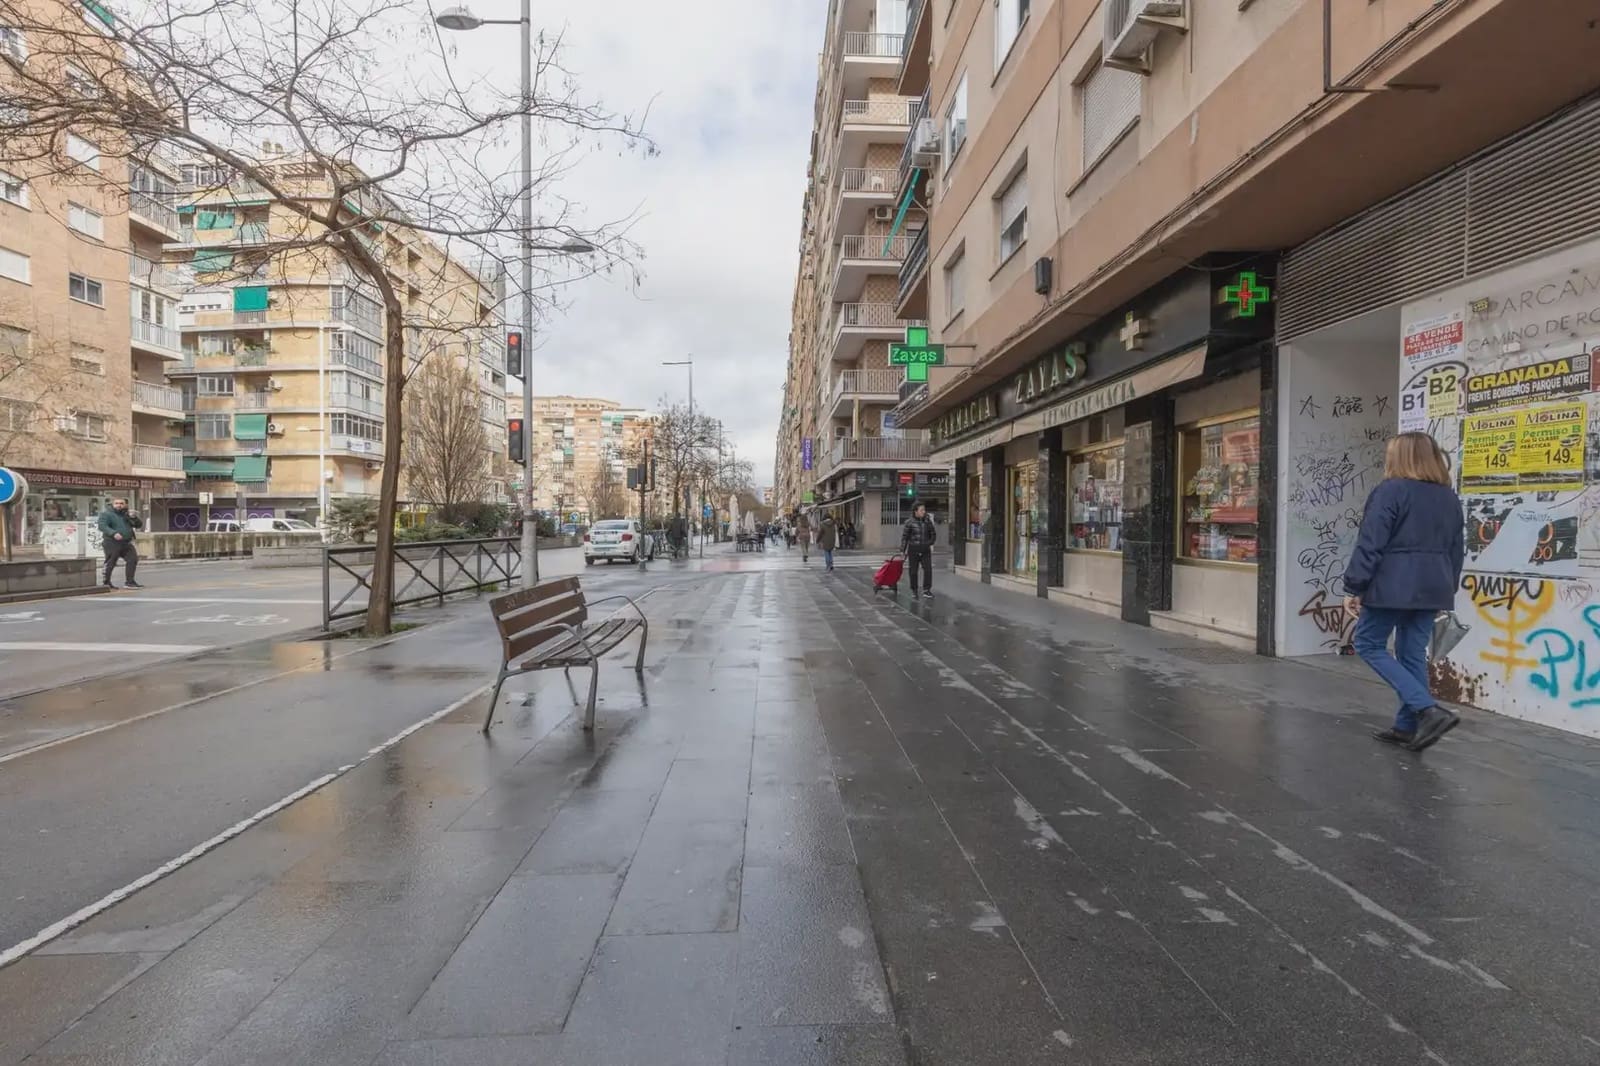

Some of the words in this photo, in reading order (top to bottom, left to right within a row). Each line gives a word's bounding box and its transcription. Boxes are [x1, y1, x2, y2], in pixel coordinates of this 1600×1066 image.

[1408, 334, 1422, 345] SE
[1423, 324, 1458, 339] VENDE
[1546, 315, 1571, 334] DE
[892, 347, 937, 362] Zayas
[1015, 344, 1081, 404] ZAYAS
[1468, 360, 1571, 392] GRANADA
[1430, 374, 1457, 396] B2
[1468, 388, 1493, 404] FRENTE
[1531, 376, 1561, 392] PARQUE
[1562, 371, 1590, 388] NORTE
[1402, 391, 1425, 411] B1
[1469, 419, 1516, 431] MOLINA
[1526, 411, 1581, 425] MOLINA
[1522, 427, 1569, 438] Permiso
[1571, 424, 1581, 434] B
